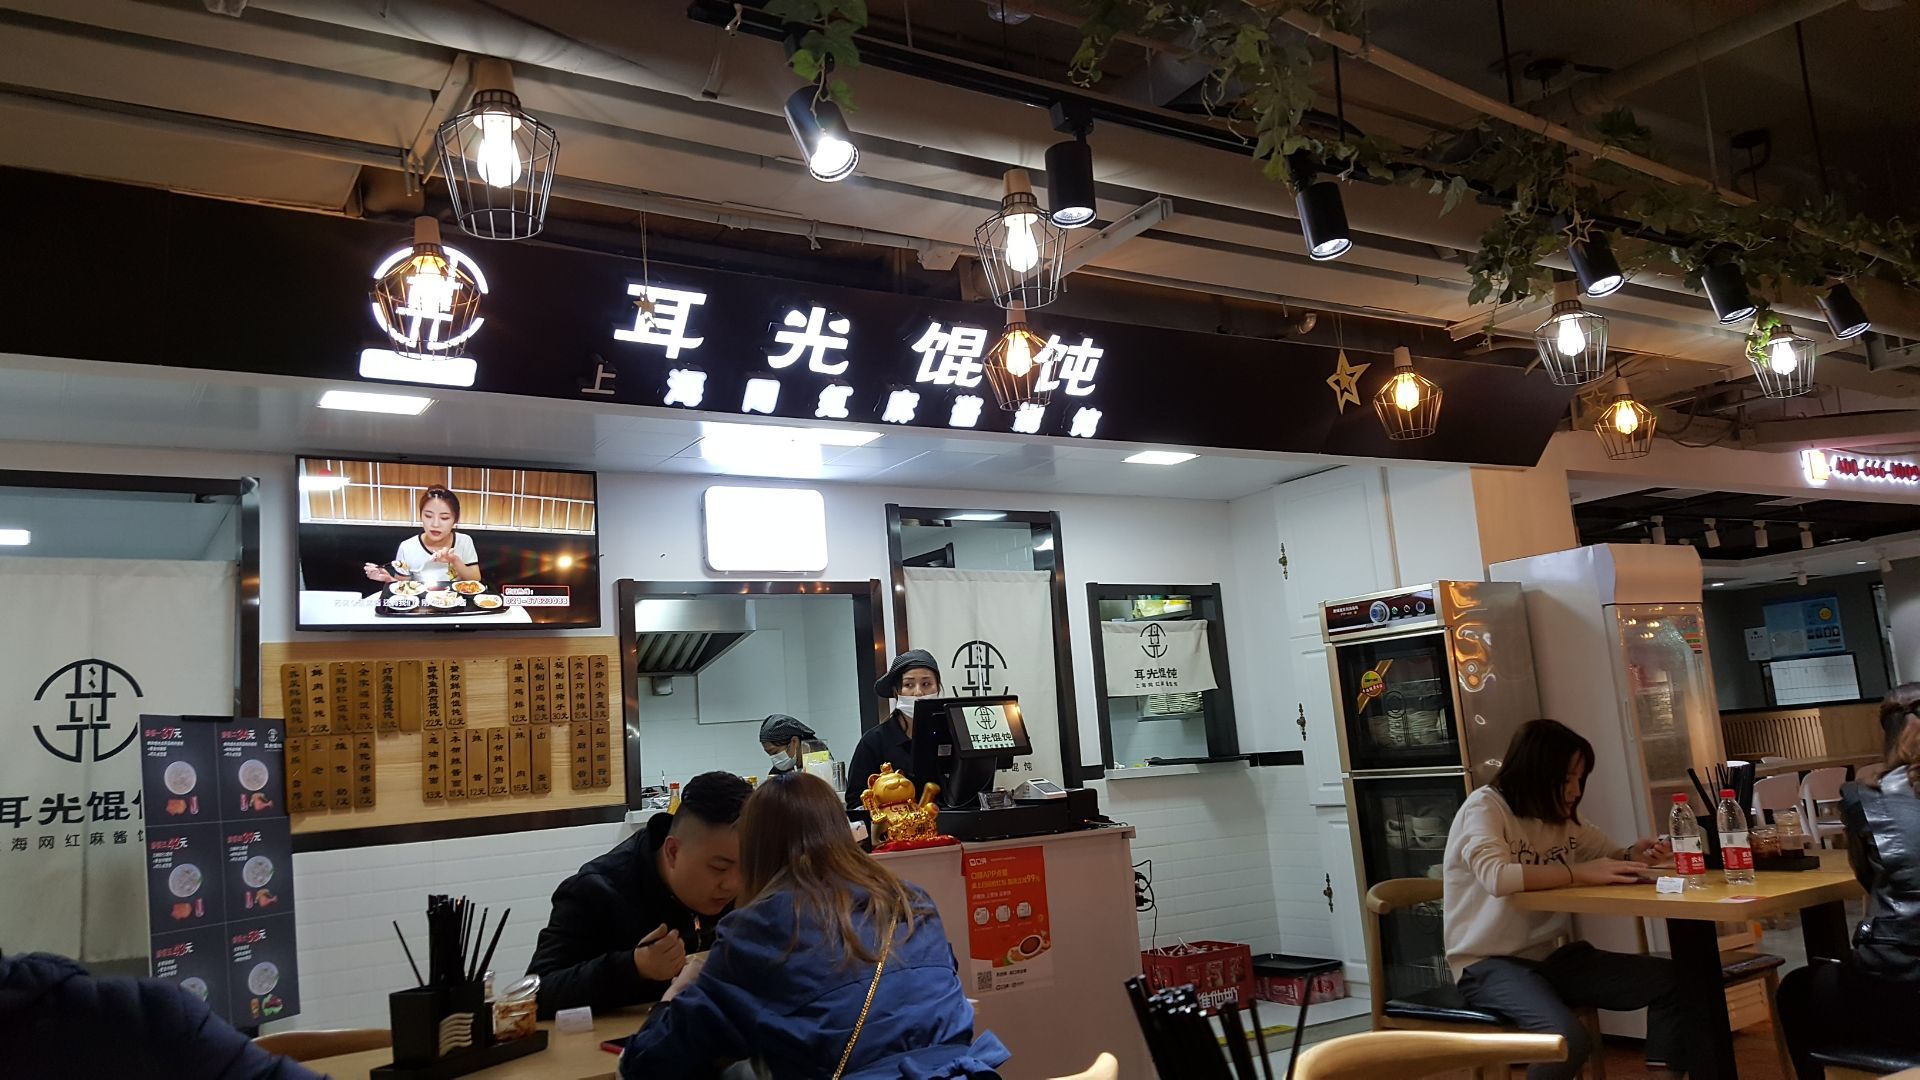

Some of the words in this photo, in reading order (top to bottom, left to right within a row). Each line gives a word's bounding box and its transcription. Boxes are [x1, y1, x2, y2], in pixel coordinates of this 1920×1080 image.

[612, 283, 1104, 397] 耳光馄饨
[1134, 667, 1178, 680] 耳光馄饨
[311, 669, 326, 718] 鲜肉馄饨
[970, 732, 1013, 743] 耳光馄饨
